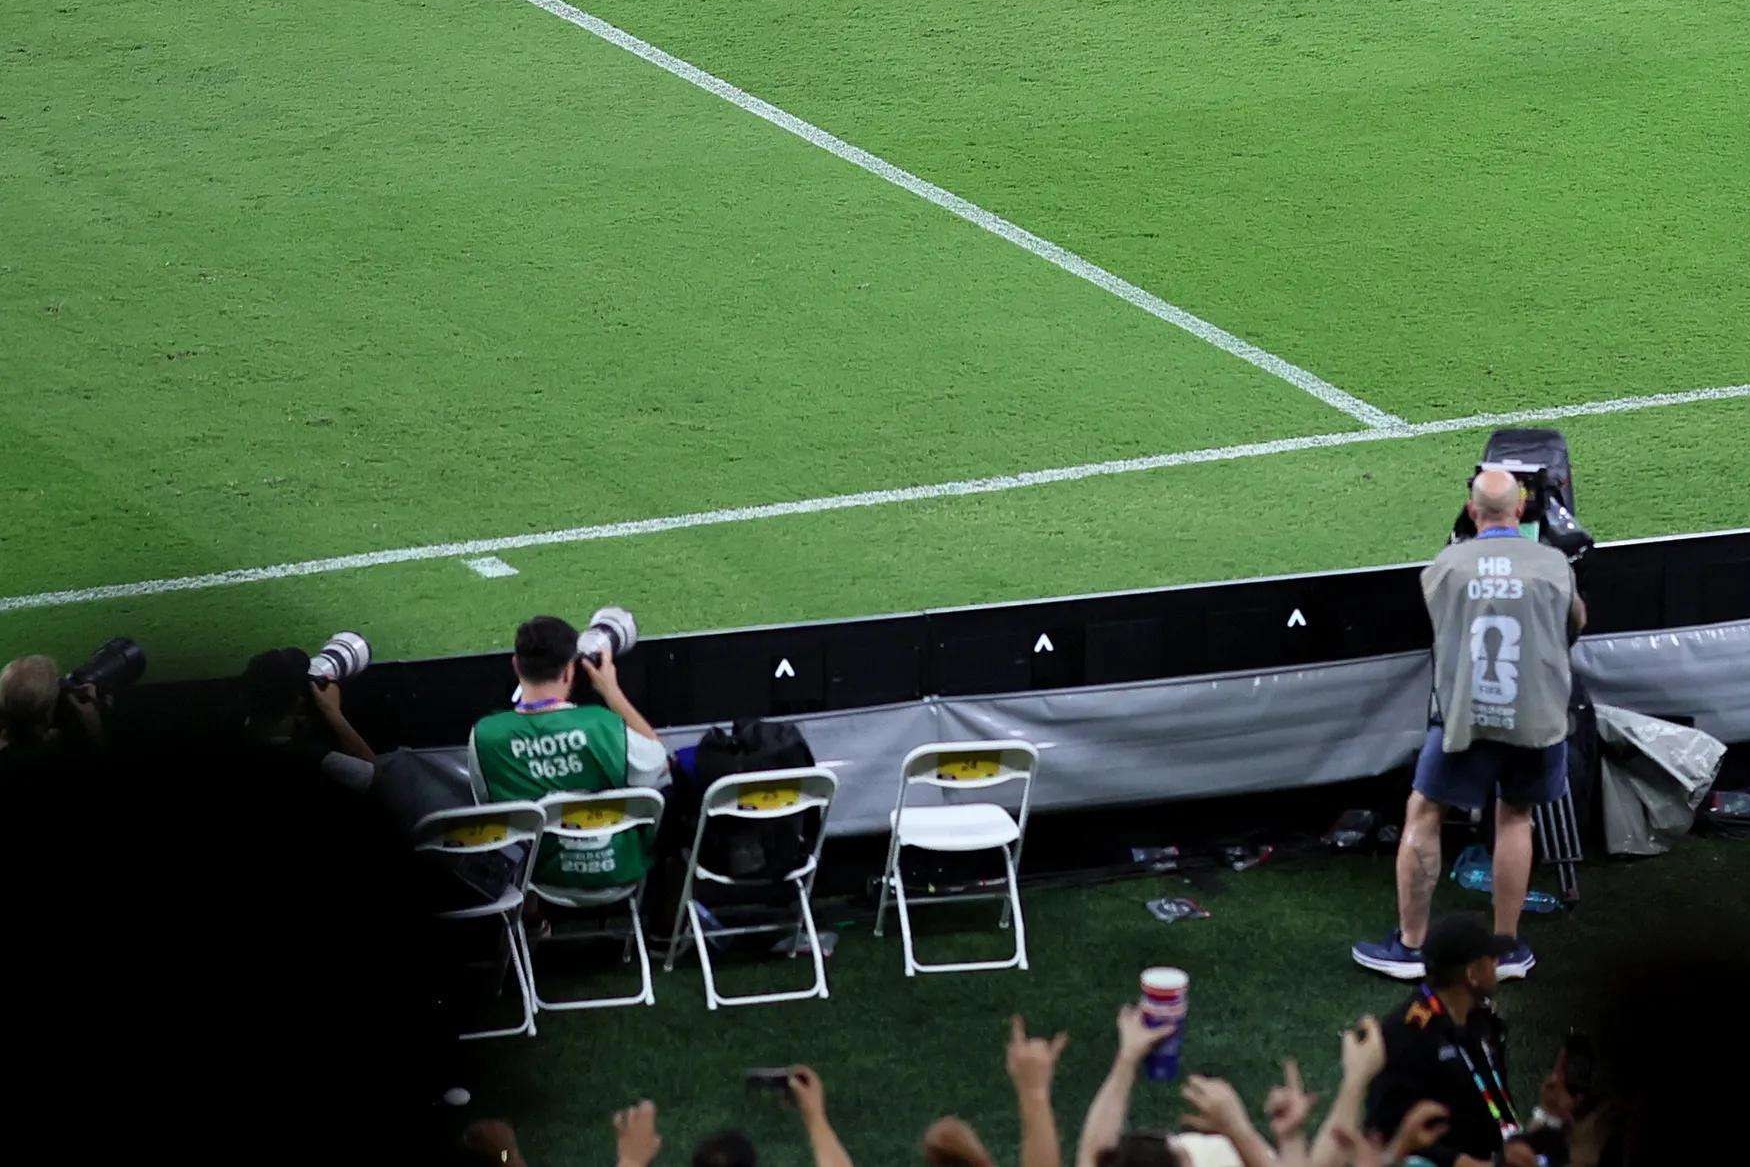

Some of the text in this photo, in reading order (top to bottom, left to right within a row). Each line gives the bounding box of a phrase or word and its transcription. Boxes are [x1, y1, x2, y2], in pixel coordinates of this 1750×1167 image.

[1477, 555, 1513, 577] HB
[1467, 578, 1524, 600] 0523
[510, 729, 587, 759] PHOTO
[527, 753, 583, 779] 0636
[561, 858, 616, 874] 2026
